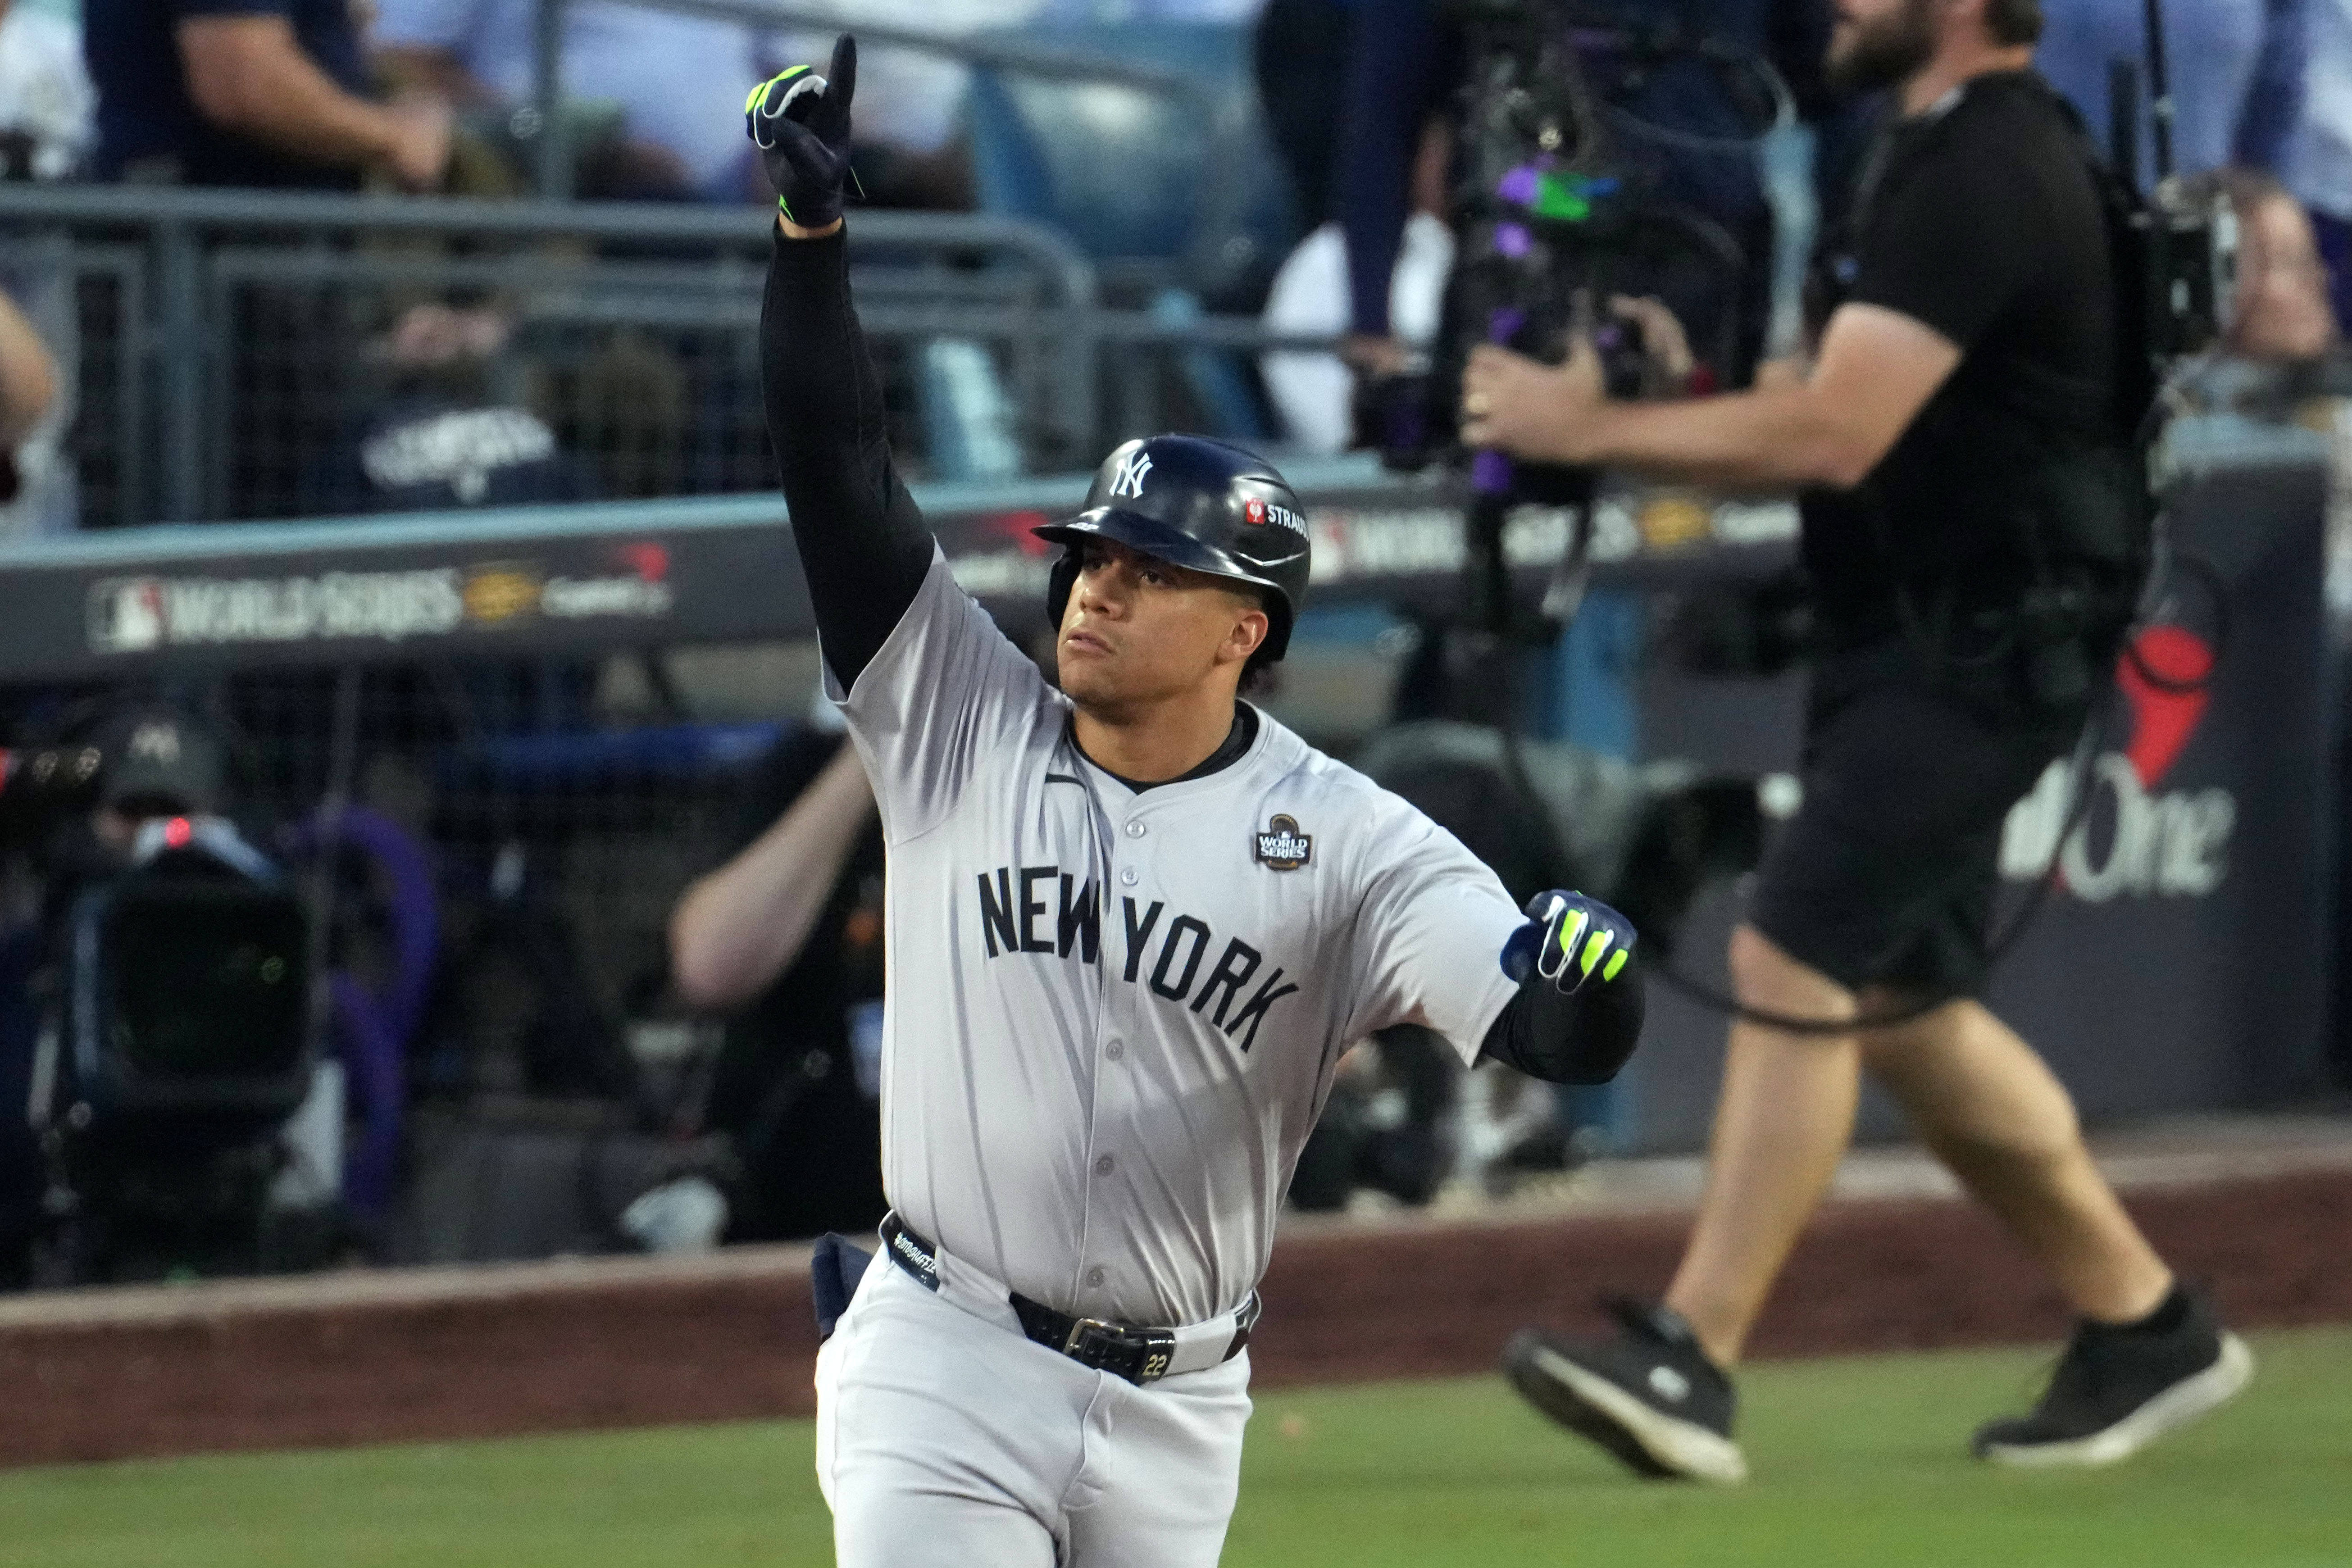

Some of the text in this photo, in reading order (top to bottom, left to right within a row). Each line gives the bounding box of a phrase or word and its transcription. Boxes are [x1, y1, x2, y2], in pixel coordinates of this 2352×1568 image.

[1109, 450, 1153, 499] NY
[1259, 836, 1308, 849] WORLD
[1260, 845, 1306, 859] SERIES
[978, 866, 1299, 1053] NEW YORK
[1142, 1354, 1167, 1377] 22
